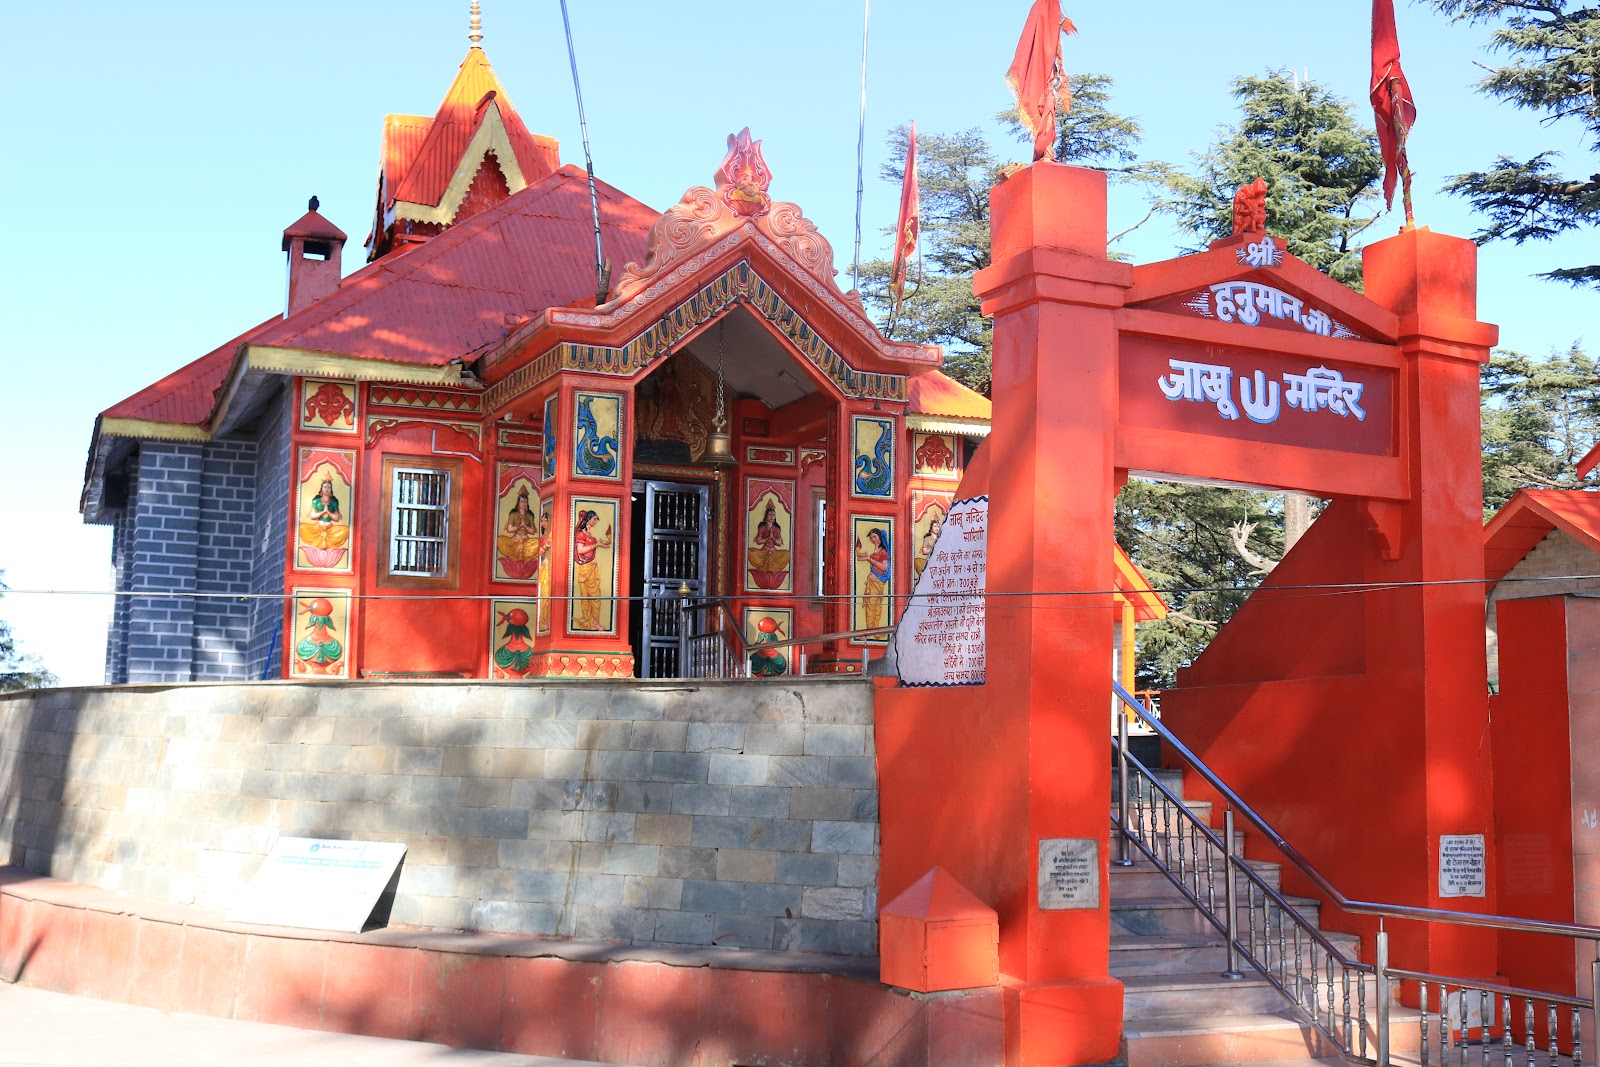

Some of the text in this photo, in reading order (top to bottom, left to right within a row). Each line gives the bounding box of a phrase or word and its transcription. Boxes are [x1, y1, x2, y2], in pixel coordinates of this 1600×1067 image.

[1245, 236, 1277, 268] श्री
[1210, 281, 1332, 337] हनुमान जी
[1158, 359, 1367, 422] जाखू मन्दिर
